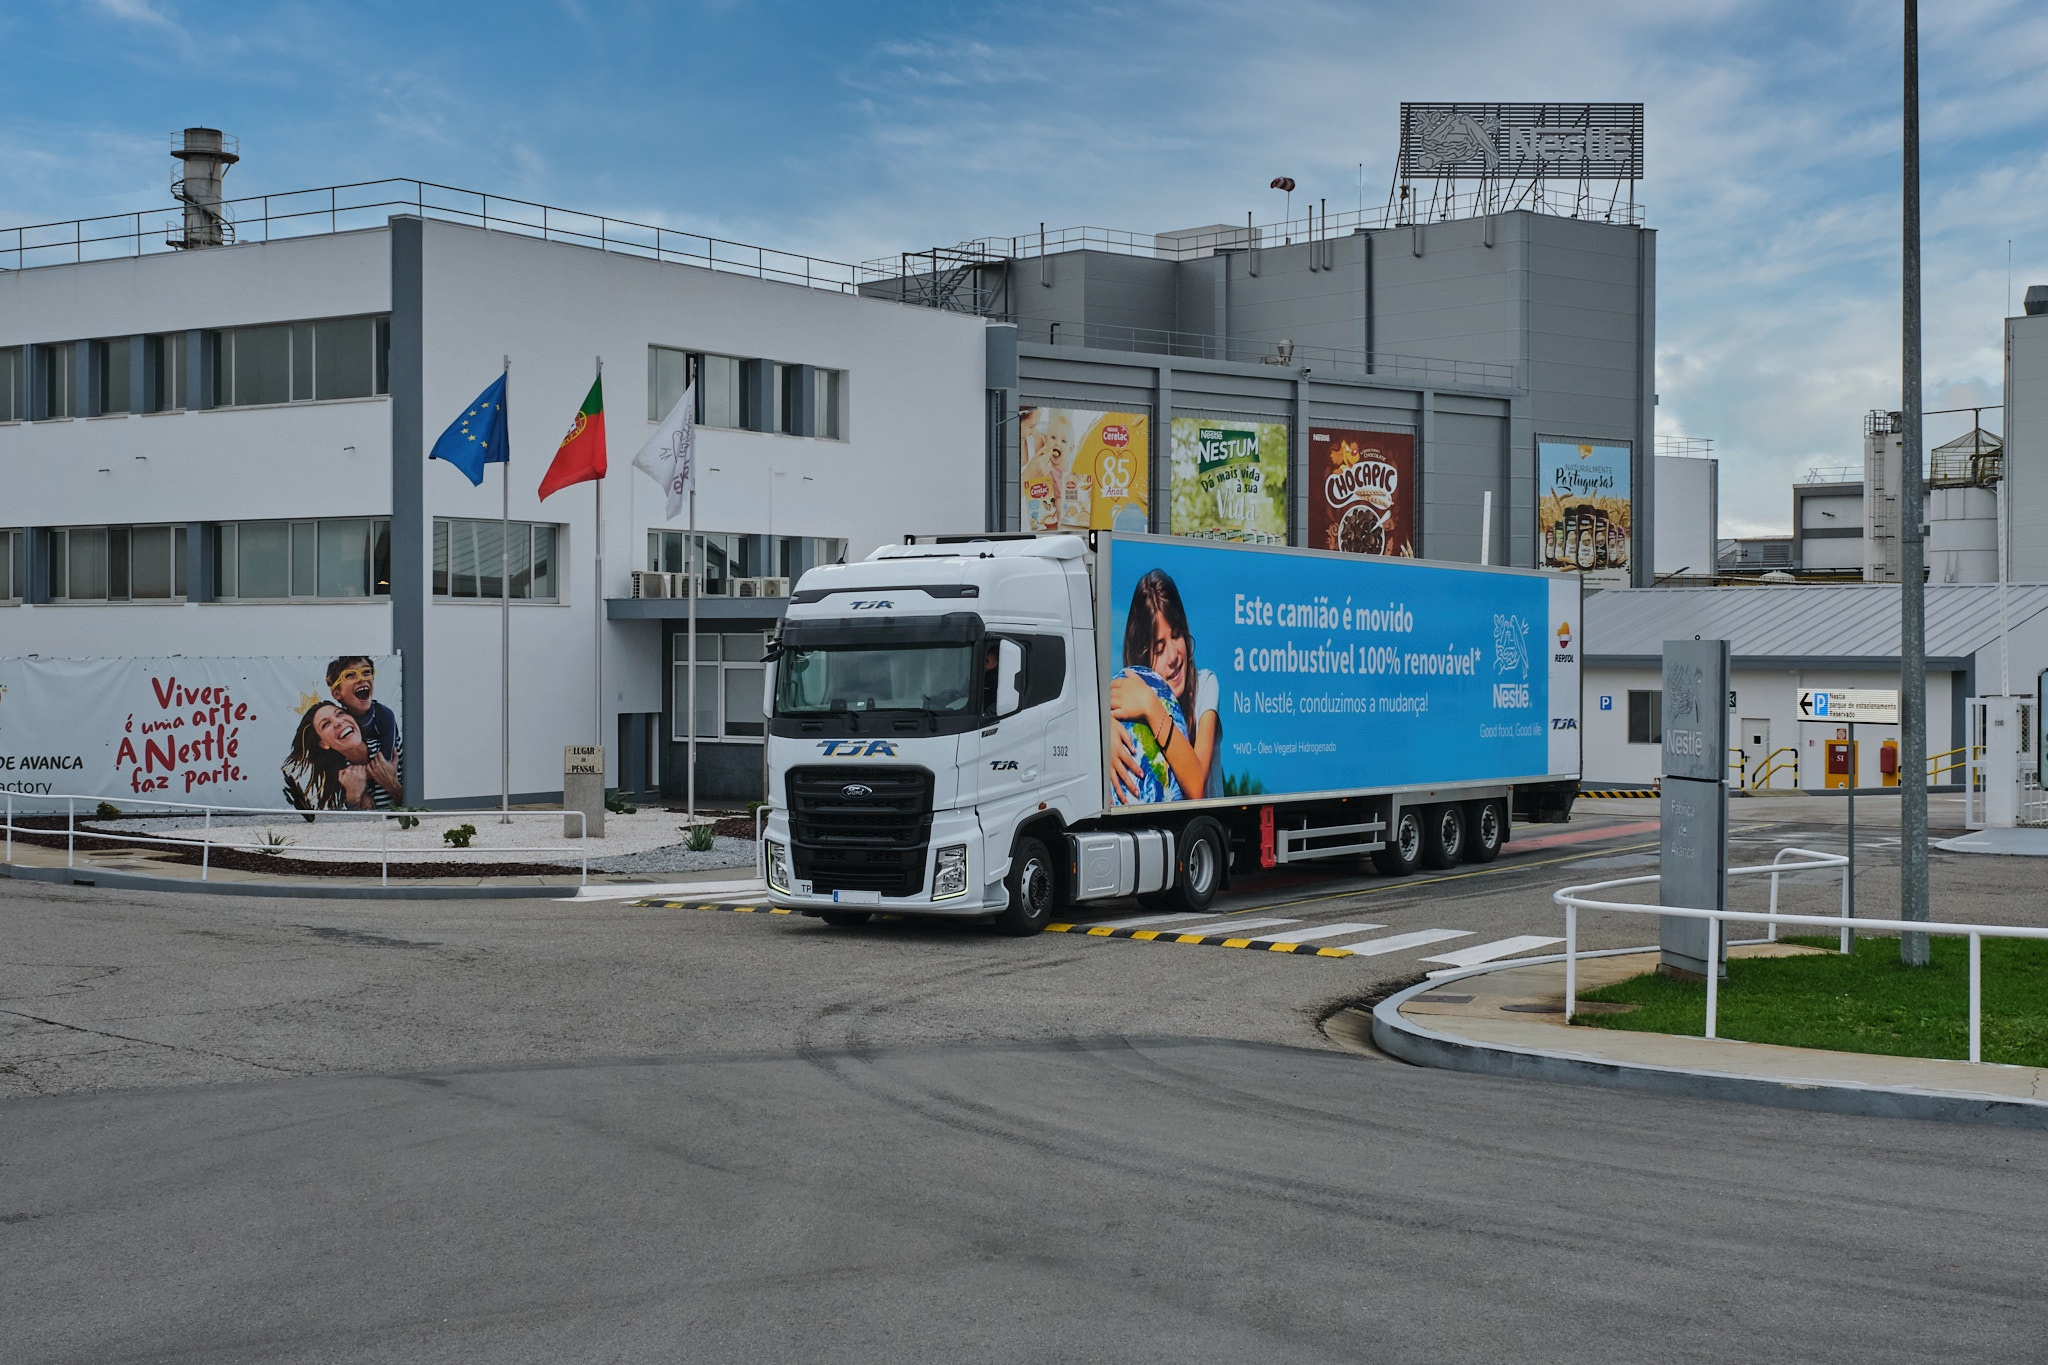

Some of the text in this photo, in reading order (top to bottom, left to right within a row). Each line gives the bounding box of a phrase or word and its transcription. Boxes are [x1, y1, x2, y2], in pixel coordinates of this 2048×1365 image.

[1510, 126, 1632, 161] Nestlé
[1102, 431, 1128, 441] Cerelac
[1197, 437, 1260, 464] NESTUM
[1102, 456, 1130, 488] 85
[1200, 466, 1260, 493] Dá mais vida
[1564, 464, 1613, 474] NATURALMENTE
[1244, 483, 1258, 494] sua
[1328, 464, 1396, 506] CHOCAPIC
[1556, 467, 1614, 495] Portuguesas
[1216, 488, 1256, 520] Vida
[850, 600, 894, 610] TJA
[1234, 594, 1414, 633] Este camião é movido
[1234, 647, 1244, 672] a
[1249, 638, 1354, 674] combustível
[1358, 647, 1401, 675] 100%
[1554, 654, 1574, 663] REPSOL
[151, 676, 225, 710] Viver
[1234, 690, 1428, 717] Na Nestlé, conduzimos a mudança!
[1493, 684, 1530, 709] Nestlé
[1816, 694, 1826, 714] P
[125, 695, 257, 734] é uma arte.
[1551, 718, 1578, 730] TJA
[1480, 724, 1498, 738] Good
[1516, 722, 1532, 737] Good
[1532, 724, 1542, 736] life
[116, 724, 238, 774] A Nestlé
[816, 740, 899, 758] TJA
[1052, 746, 1068, 756] 3302
[1258, 739, 1272, 754] Óleo
[1274, 742, 1298, 756] Vegetal
[1298, 740, 1337, 755] Hidrogenado
[1666, 729, 1702, 756] Nestlé
[20, 756, 84, 770] AVANCA
[990, 760, 1019, 770] TJA
[130, 757, 248, 794] faz parte.
[1678, 822, 1687, 836] de
[1671, 841, 1695, 858] Avanca
[801, 884, 812, 892] TP
